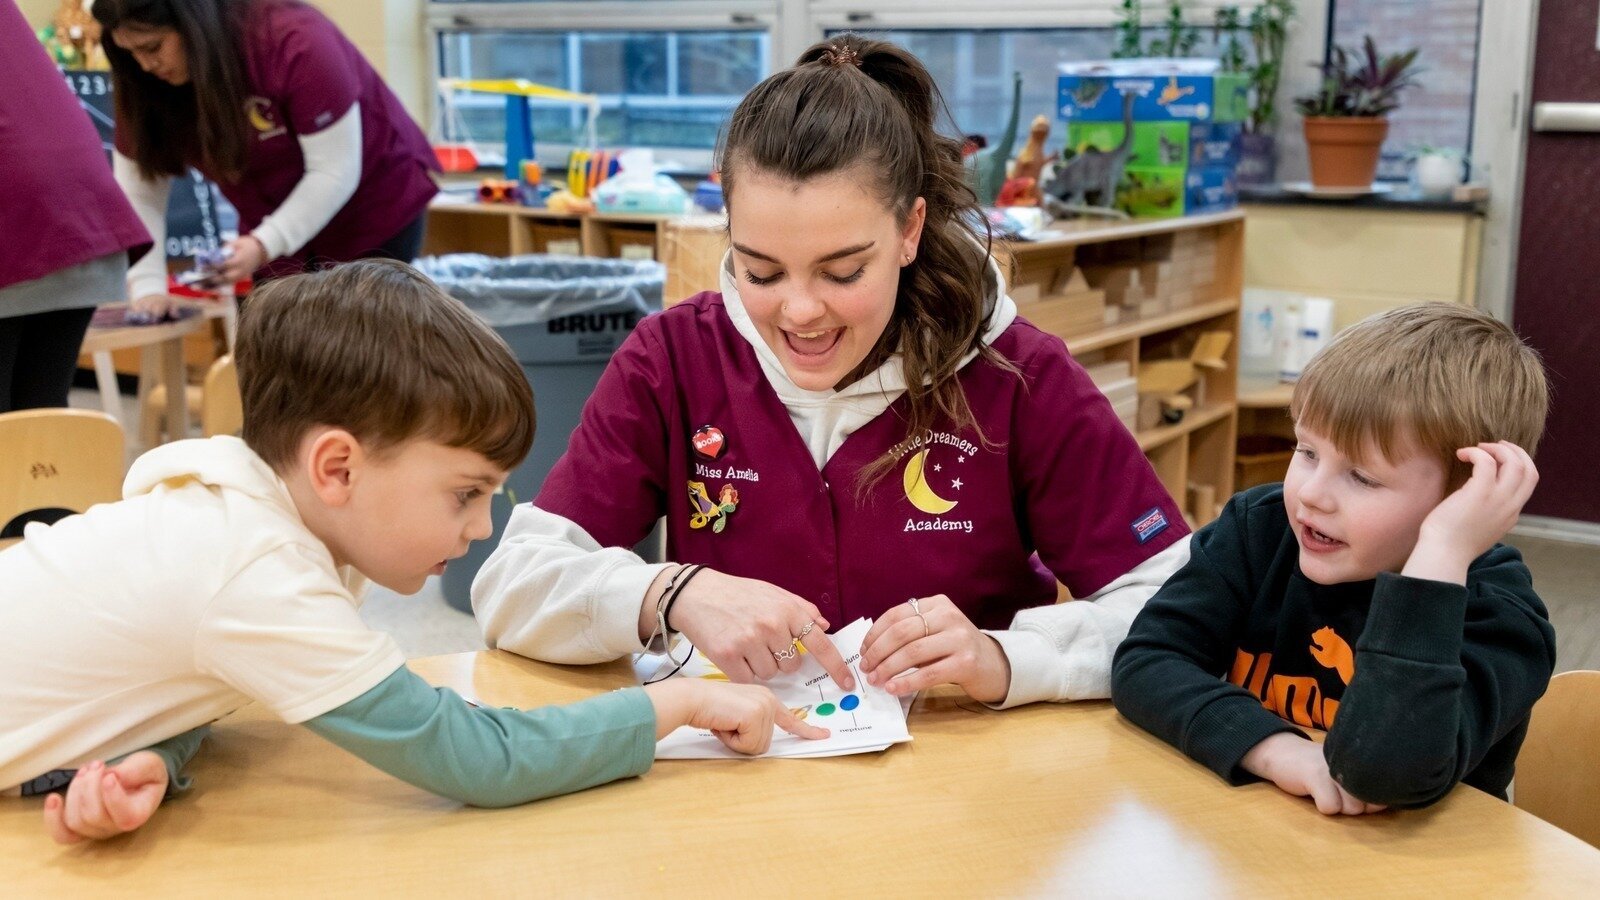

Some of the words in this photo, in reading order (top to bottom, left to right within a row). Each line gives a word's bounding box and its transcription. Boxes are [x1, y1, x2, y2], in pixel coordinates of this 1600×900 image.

[548, 311, 639, 333] BRUTE
[925, 429, 978, 457] Dreamers
[696, 463, 722, 478] Miss
[725, 466, 759, 482] Amelia
[904, 517, 973, 533] Academy
[805, 672, 829, 687] uranus
